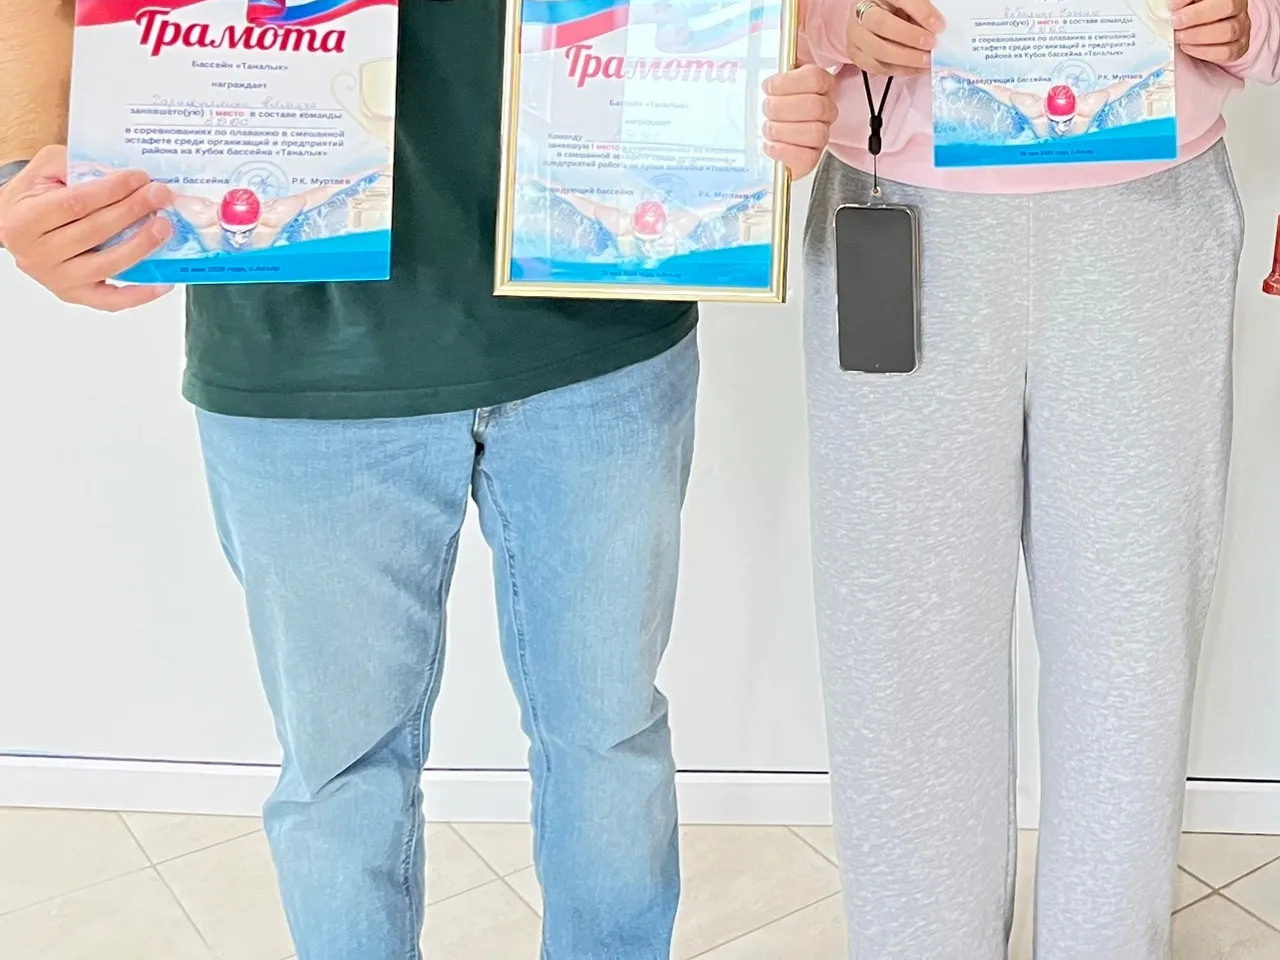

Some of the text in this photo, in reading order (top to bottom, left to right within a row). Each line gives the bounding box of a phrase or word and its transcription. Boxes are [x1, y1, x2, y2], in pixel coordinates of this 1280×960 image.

[135, 10, 346, 57] Грамота
[1032, 43, 1079, 51] организаций
[565, 44, 739, 88] Грамота
[141, 147, 178, 155] района
[195, 148, 224, 156] Кубок
[227, 148, 273, 156] бассейна
[182, 176, 230, 184] бассейна
